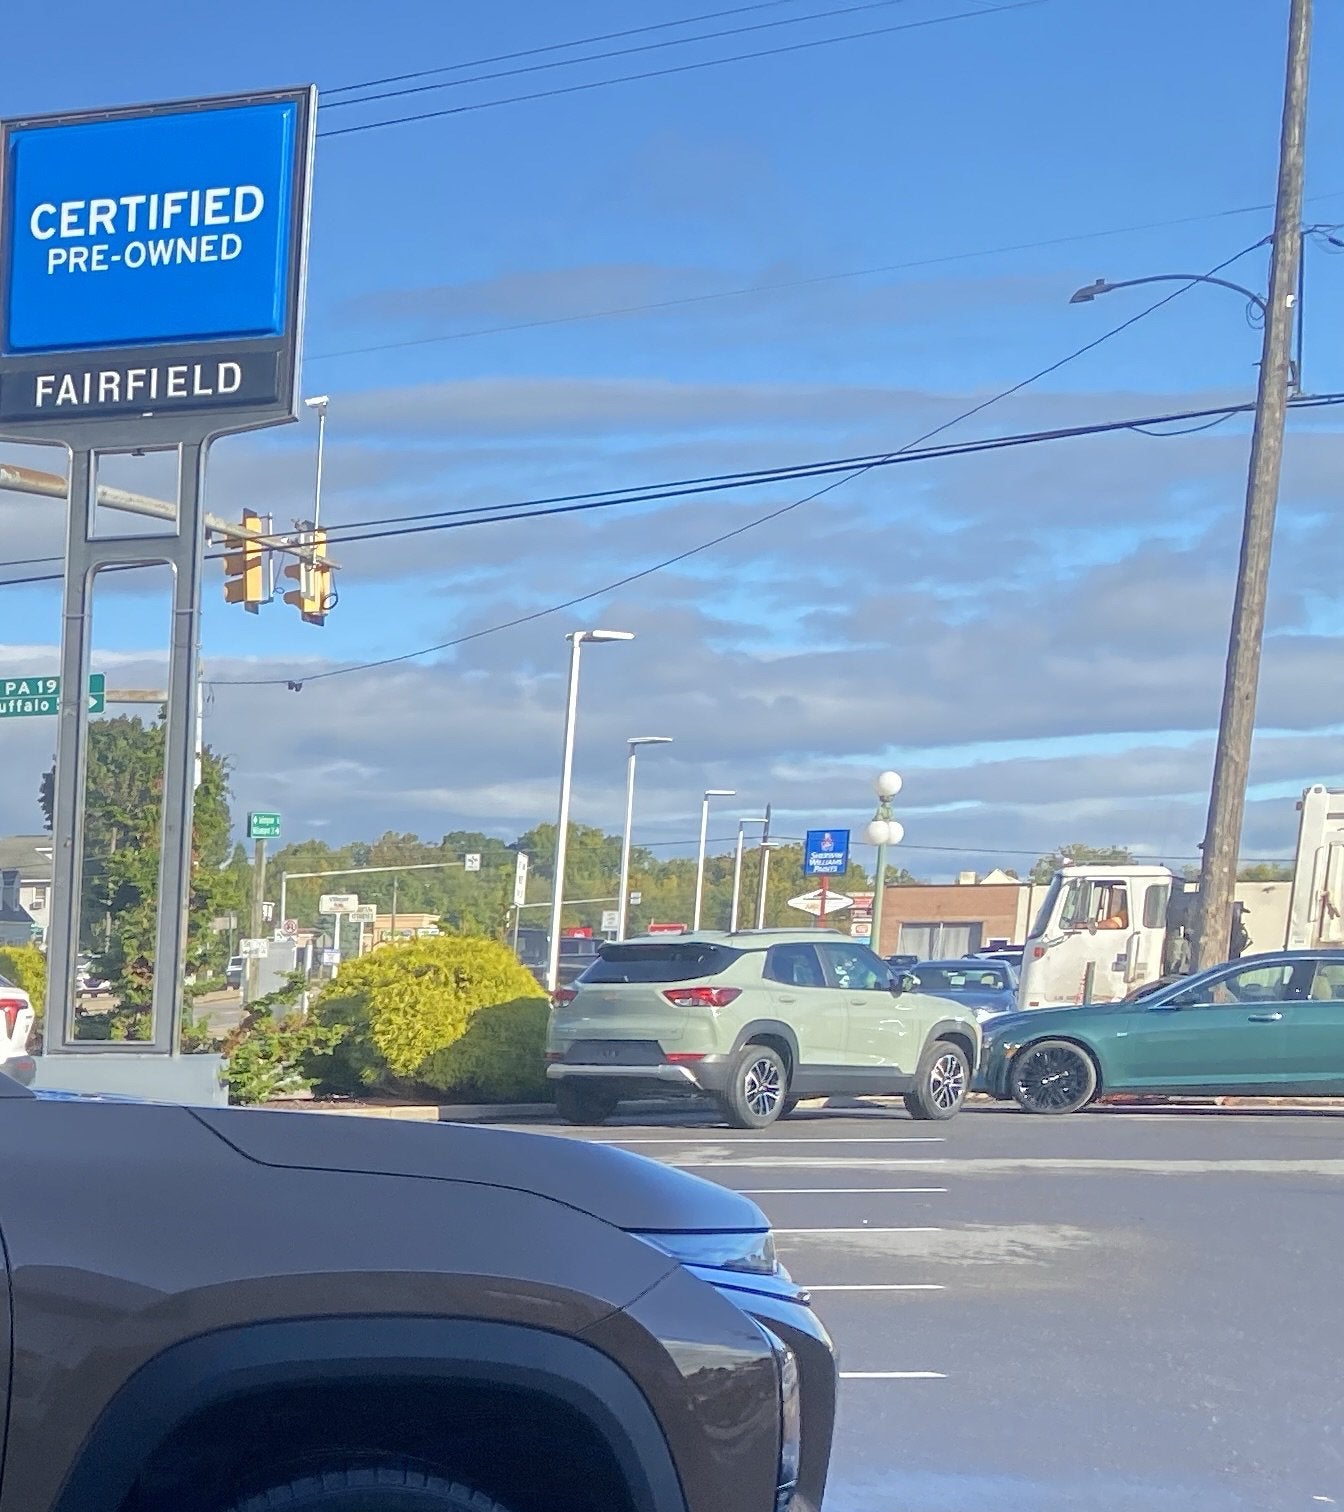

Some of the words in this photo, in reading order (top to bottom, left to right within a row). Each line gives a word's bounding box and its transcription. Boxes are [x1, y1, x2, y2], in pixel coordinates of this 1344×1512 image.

[29, 185, 265, 241] CERTIFIED
[47, 233, 243, 275] PRE-OWNED
[35, 361, 243, 408] FAIRFIELD
[5, 681, 30, 695] PA
